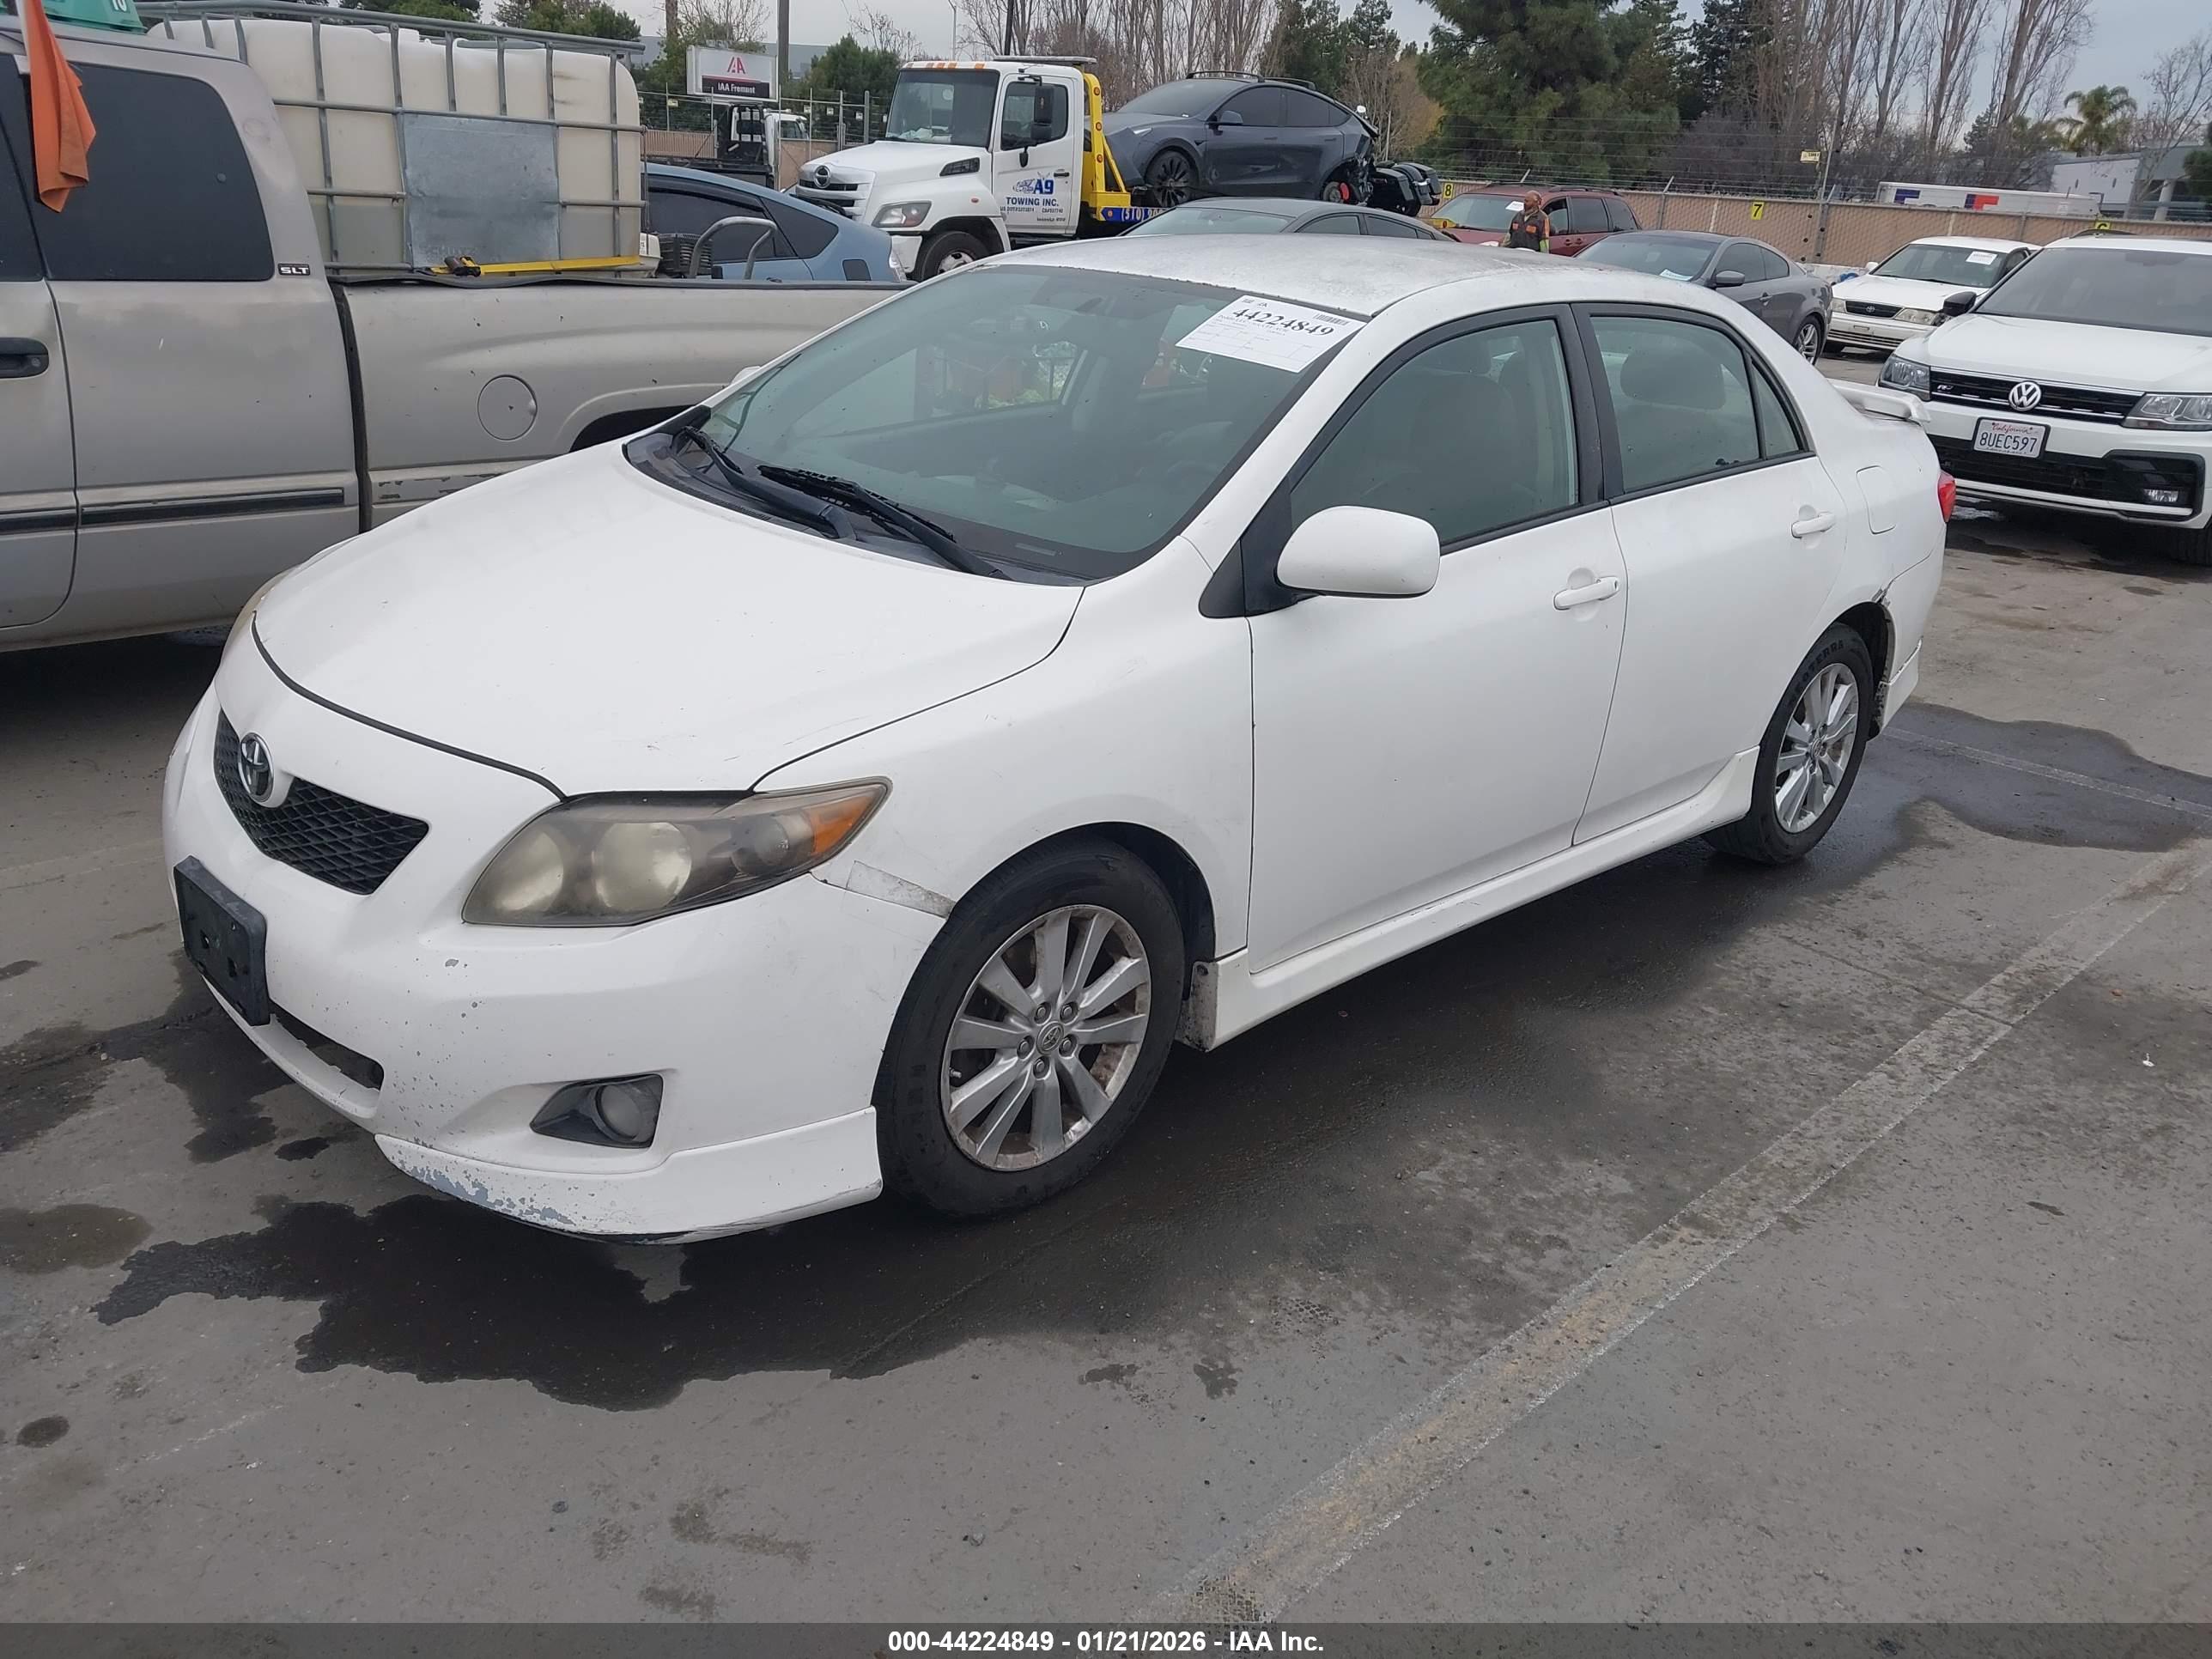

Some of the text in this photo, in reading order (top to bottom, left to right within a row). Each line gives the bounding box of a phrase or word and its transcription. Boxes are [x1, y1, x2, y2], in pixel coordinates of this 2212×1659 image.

[718, 82, 730, 92] IAA
[1032, 178, 1054, 195] A9
[1444, 184, 1452, 197] 8
[1006, 197, 1059, 207] TOWING INC.
[1753, 204, 1763, 217] 7
[280, 266, 309, 275] SLT
[1232, 308, 1334, 336] 44224849
[1992, 423, 2029, 434] California
[1979, 432, 2038, 453] 8UEC597
